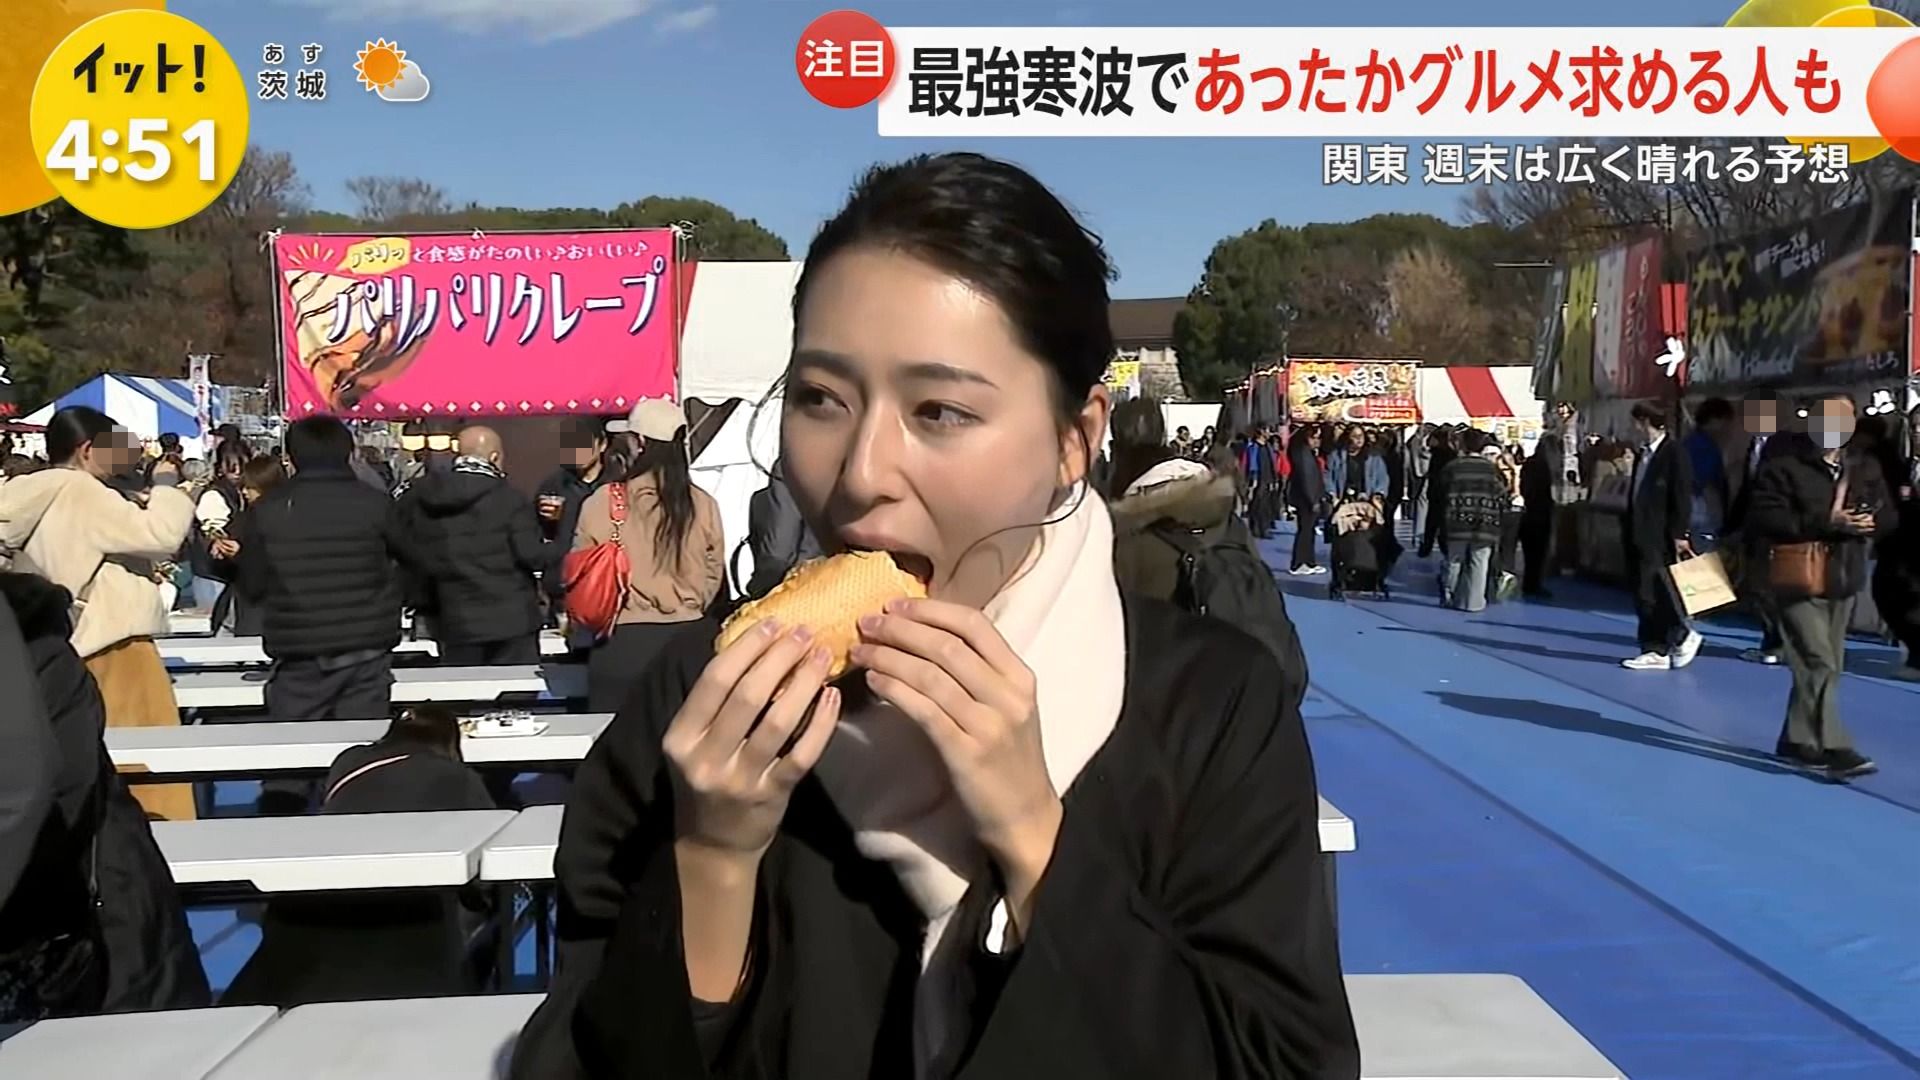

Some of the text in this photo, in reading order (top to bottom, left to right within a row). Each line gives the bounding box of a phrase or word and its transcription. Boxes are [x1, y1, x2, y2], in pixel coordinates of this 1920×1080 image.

[327, 255, 667, 347] パリパリクレープ
